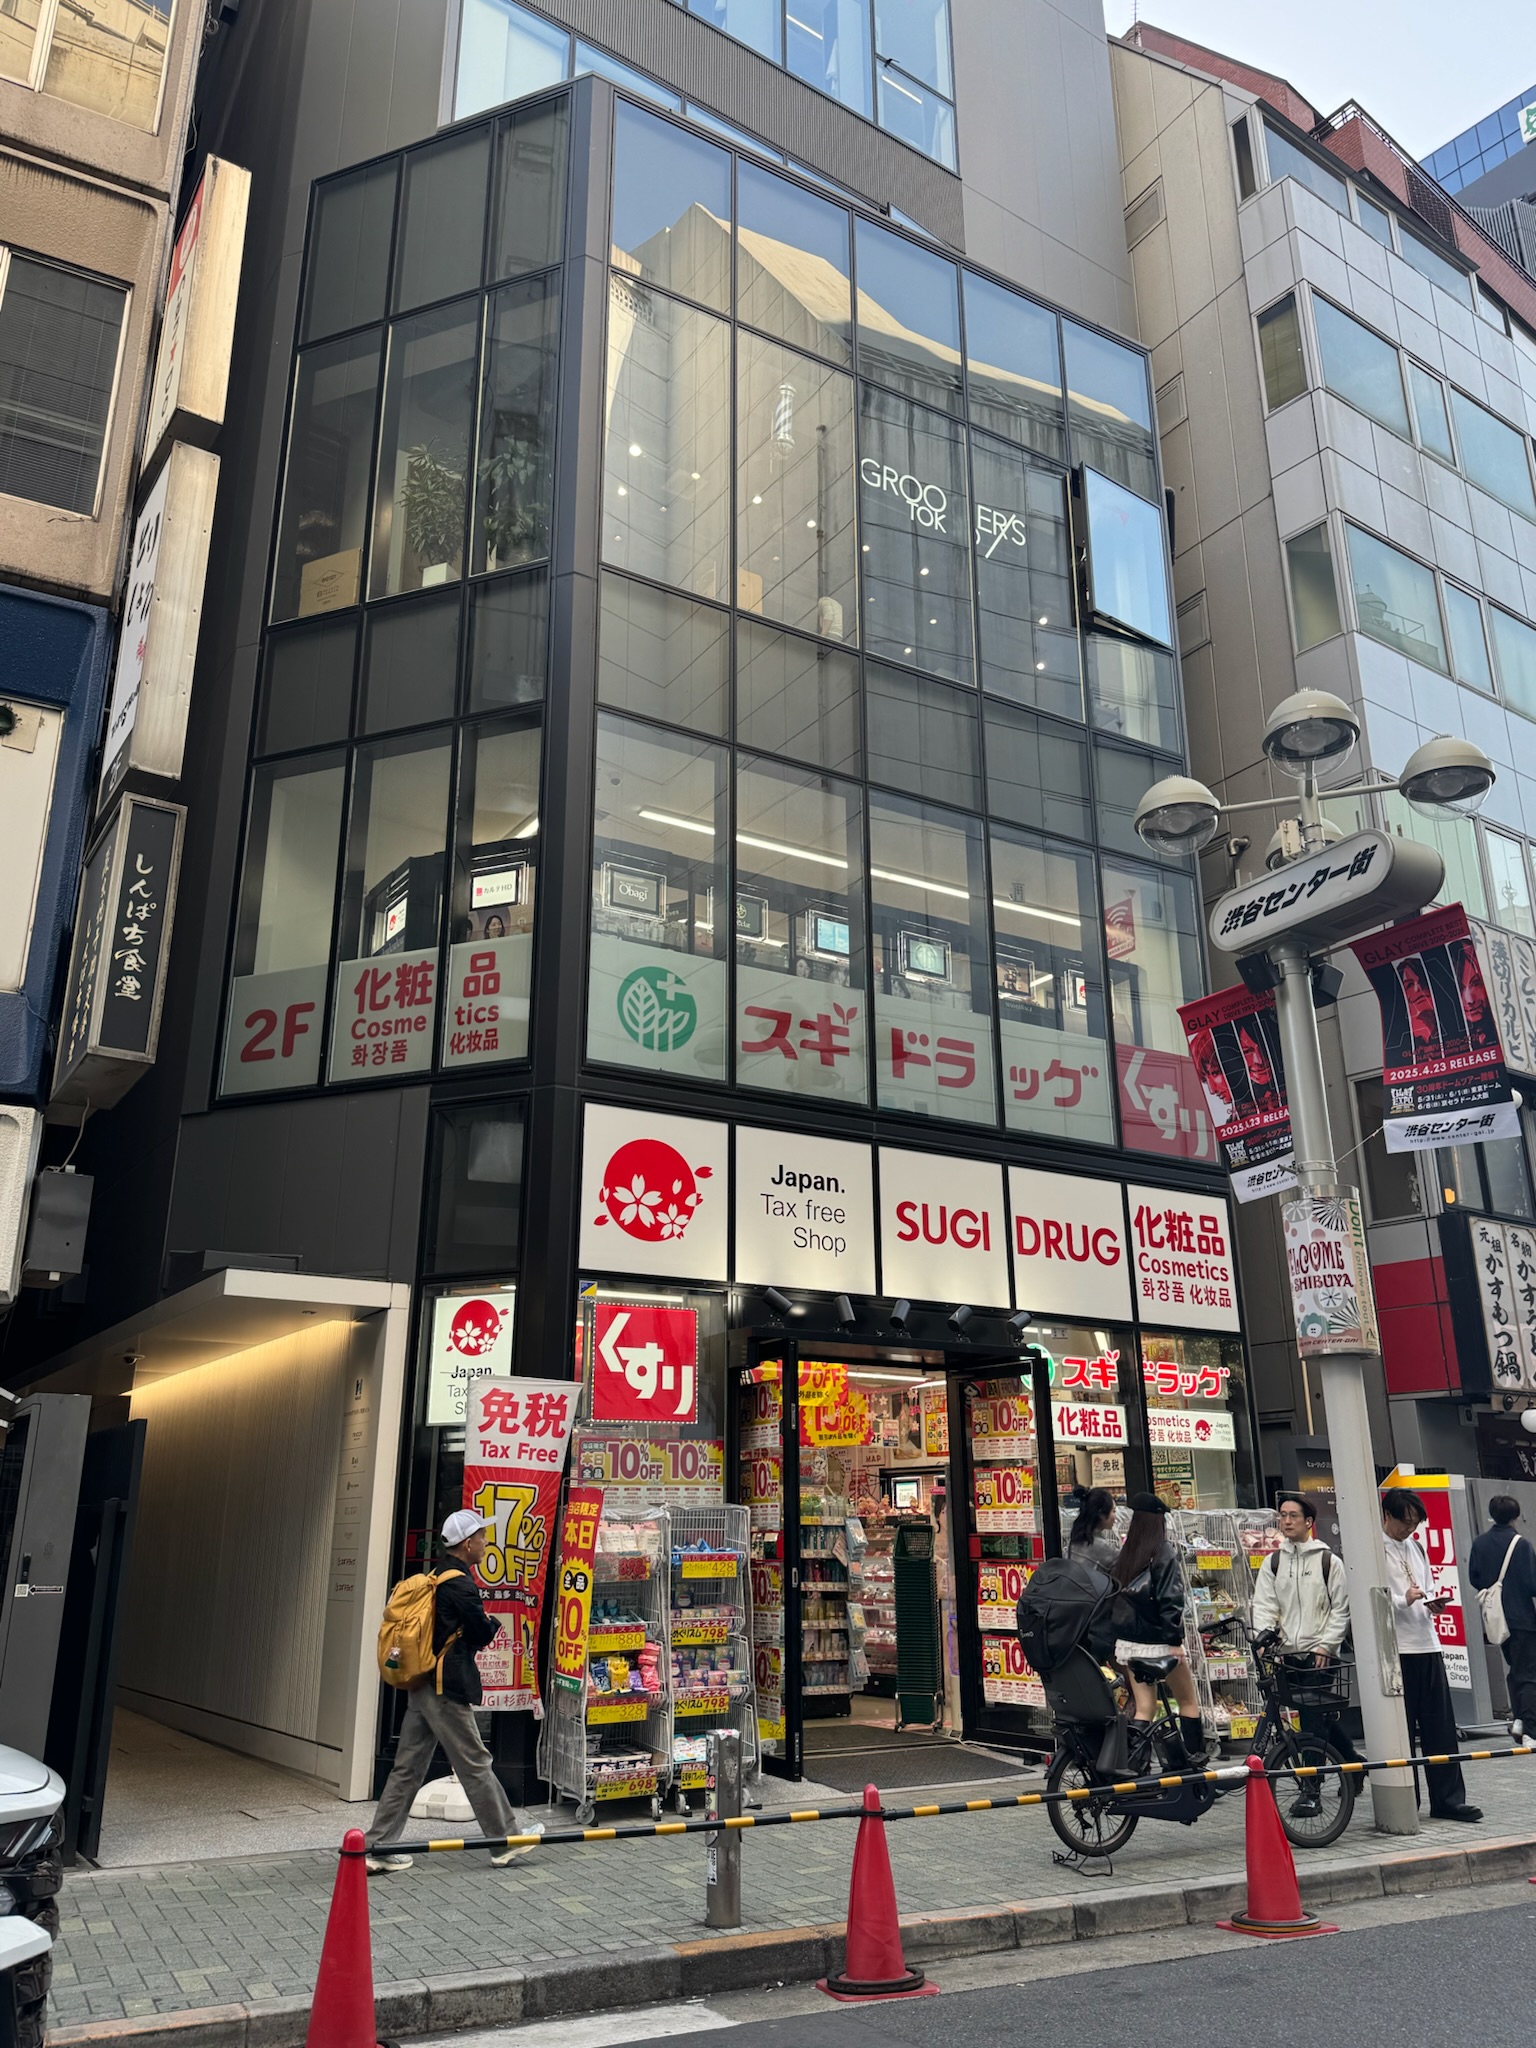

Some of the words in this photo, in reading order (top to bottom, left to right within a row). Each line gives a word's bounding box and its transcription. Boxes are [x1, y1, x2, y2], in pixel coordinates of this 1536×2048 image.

[619, 884, 648, 902] Obagi
[1220, 844, 1378, 935] 渋谷センター街
[114, 853, 157, 1001] しんぱち食堂
[1404, 926, 1444, 945] COMPLETE
[1446, 918, 1463, 931] BEST
[1363, 941, 1404, 965] GLAY
[1187, 1009, 1220, 1031] GLAY
[240, 1002, 315, 1063] 2F
[450, 1028, 498, 1056] 化妆品
[351, 1039, 408, 1067] 화장품
[1390, 1061, 1447, 1081] 2025.4.23
[1449, 1049, 1497, 1070] RELEASE
[1123, 1051, 1207, 1157] くすり
[1263, 1109, 1290, 1124] RELEA
[1404, 1113, 1496, 1138] 渋谷センター街
[771, 1164, 846, 1194] Japan.
[760, 1193, 798, 1218] Tax
[806, 1199, 846, 1224] free
[793, 1227, 846, 1257] Shop
[896, 1200, 991, 1252] SUGI
[1015, 1215, 1121, 1266] DRUG
[1134, 1205, 1225, 1257] 化粧品
[1138, 1252, 1229, 1282] Cosmetics
[1288, 1241, 1345, 1277] ELCOME
[1142, 1278, 1185, 1303] 화장품
[1190, 1284, 1232, 1308] 化妆品
[1294, 1273, 1354, 1292] SHIBUYA
[598, 1312, 694, 1415] くすり
[1062, 1350, 1120, 1391] スギ
[812, 1368, 841, 1389] OFF
[478, 1387, 569, 1439] 免税
[973, 1412, 988, 1422] 本日
[990, 1400, 1018, 1432] 10%
[1012, 1417, 1028, 1431] OFF
[1057, 1406, 1122, 1438] 化粧品
[1167, 1430, 1192, 1443] 化妆品
[480, 1440, 510, 1459] Tax
[517, 1442, 558, 1463] Free
[581, 1453, 604, 1466] 本日
[607, 1442, 649, 1479] 10%
[667, 1442, 707, 1479] 10%
[865, 1454, 881, 1463] MAP
[581, 1467, 604, 1479] 全品
[640, 1464, 663, 1479] OFF
[699, 1464, 721, 1480] OFF
[1103, 1459, 1120, 1473] 免税
[976, 1482, 992, 1493] 本日
[993, 1472, 1022, 1504] 10%
[1016, 1489, 1032, 1504] OFF
[568, 1501, 599, 1517] 当店限定
[564, 1518, 595, 1550] 本日
[478, 1544, 541, 1587] OFF
[711, 1562, 734, 1572] 428
[980, 1577, 997, 1588] 本日
[618, 1634, 642, 1645] 880
[702, 1628, 725, 1638] 798
[558, 1642, 582, 1661] OFF
[984, 1650, 1000, 1661] 本日
[1449, 1672, 1469, 1683] Shop
[481, 1695, 500, 1707] UGI
[619, 1704, 644, 1717] 328
[703, 1698, 725, 1709] 798
[629, 1779, 652, 1791] 698
